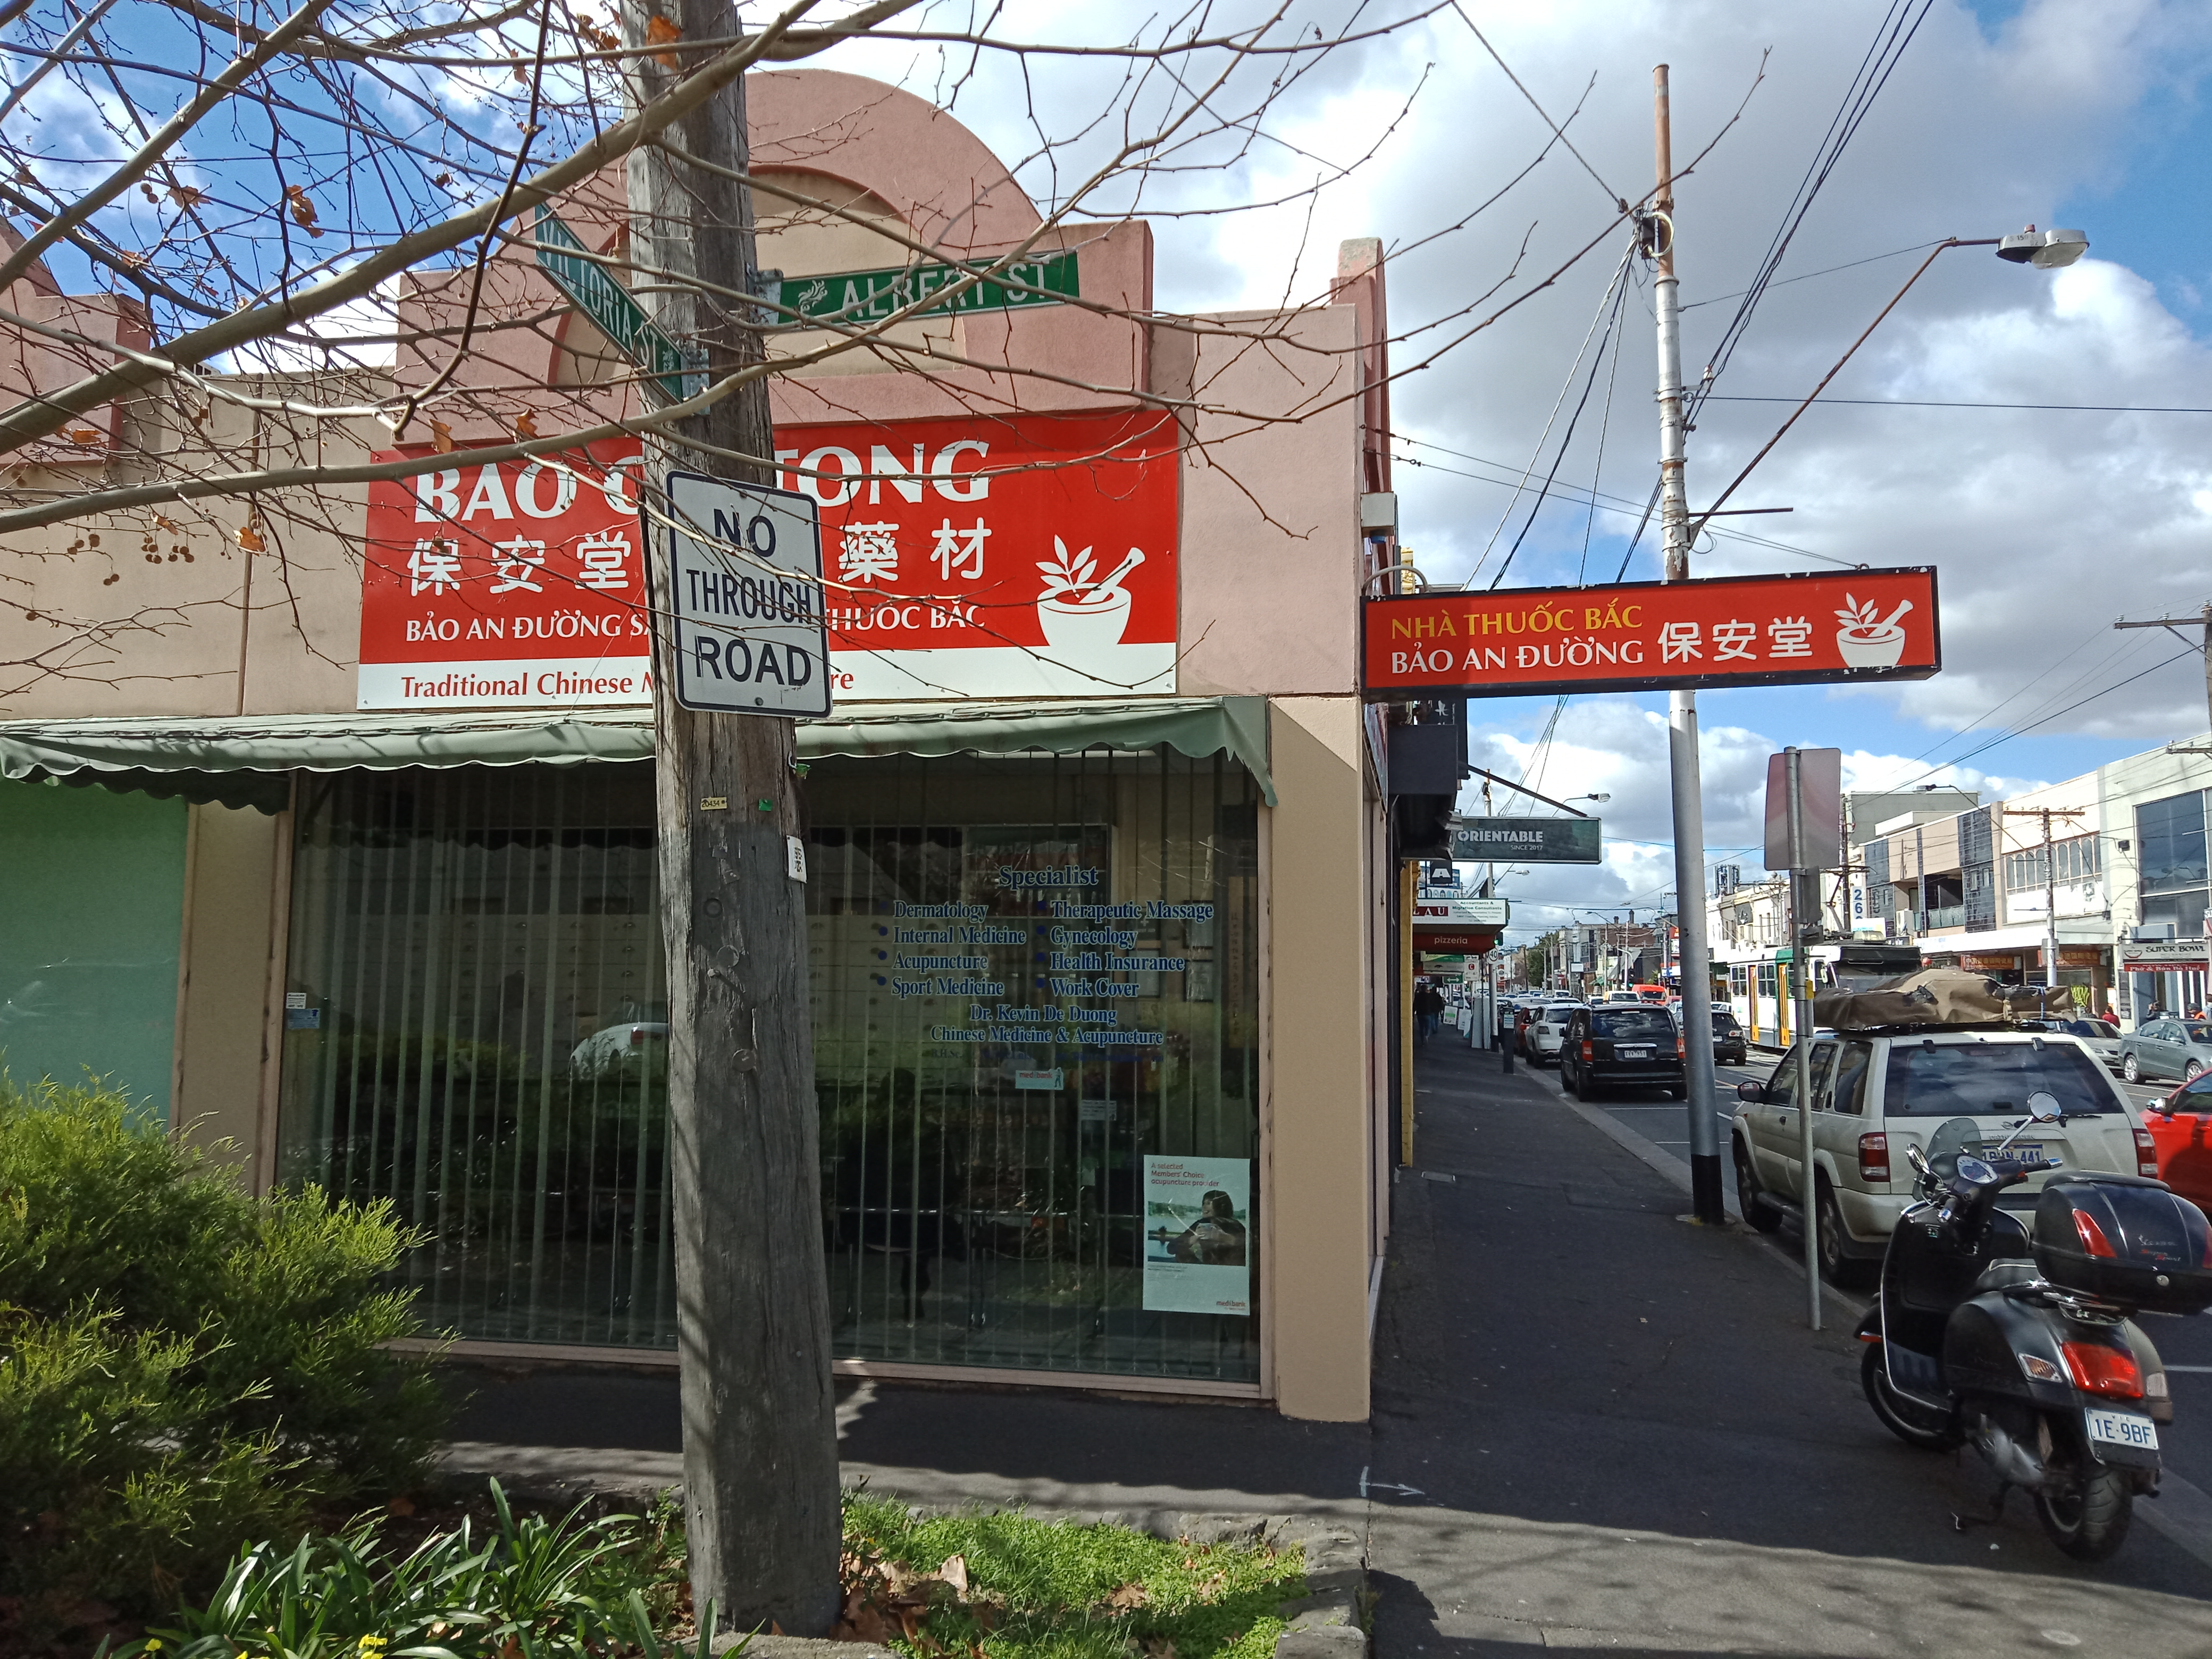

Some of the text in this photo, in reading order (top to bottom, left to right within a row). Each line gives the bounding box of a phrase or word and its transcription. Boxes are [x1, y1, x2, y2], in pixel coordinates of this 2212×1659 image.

[842, 261, 1051, 317] ALBERT ST
[640, 320, 659, 374] ST
[414, 458, 577, 523] BAO
[713, 508, 776, 558] NO
[686, 568, 811, 624] THROUGH
[406, 610, 459, 642] BẢO
[466, 617, 505, 640] AN
[512, 609, 621, 639] ĐƯỜNG
[1392, 597, 1643, 639] NHÀ THUỐC BẮC
[1657, 615, 1813, 664] 保安堂
[694, 635, 811, 687] ROAD
[1392, 635, 1644, 674] BẢO AN ĐƯỜNG
[401, 672, 528, 697] Traditional
[537, 671, 633, 696] Chinese
[1457, 830, 1543, 843] ORIENTABLE
[999, 865, 1099, 891] Specialist
[894, 900, 988, 923] Dermatology
[1051, 900, 1214, 924] Therapeutic Massage
[894, 926, 1026, 944] Internal Medicine
[1051, 926, 1138, 950] Gynecology
[892, 951, 988, 974] Acupuncture
[1050, 952, 1185, 971] Health Insurance
[892, 977, 1004, 1000] Sport Medicine
[1050, 977, 1139, 998] Work Cover
[970, 1004, 1117, 1026] Dr. Kevin De Duong
[931, 1025, 1163, 1047] Chinese Medicine & Acupuncture
